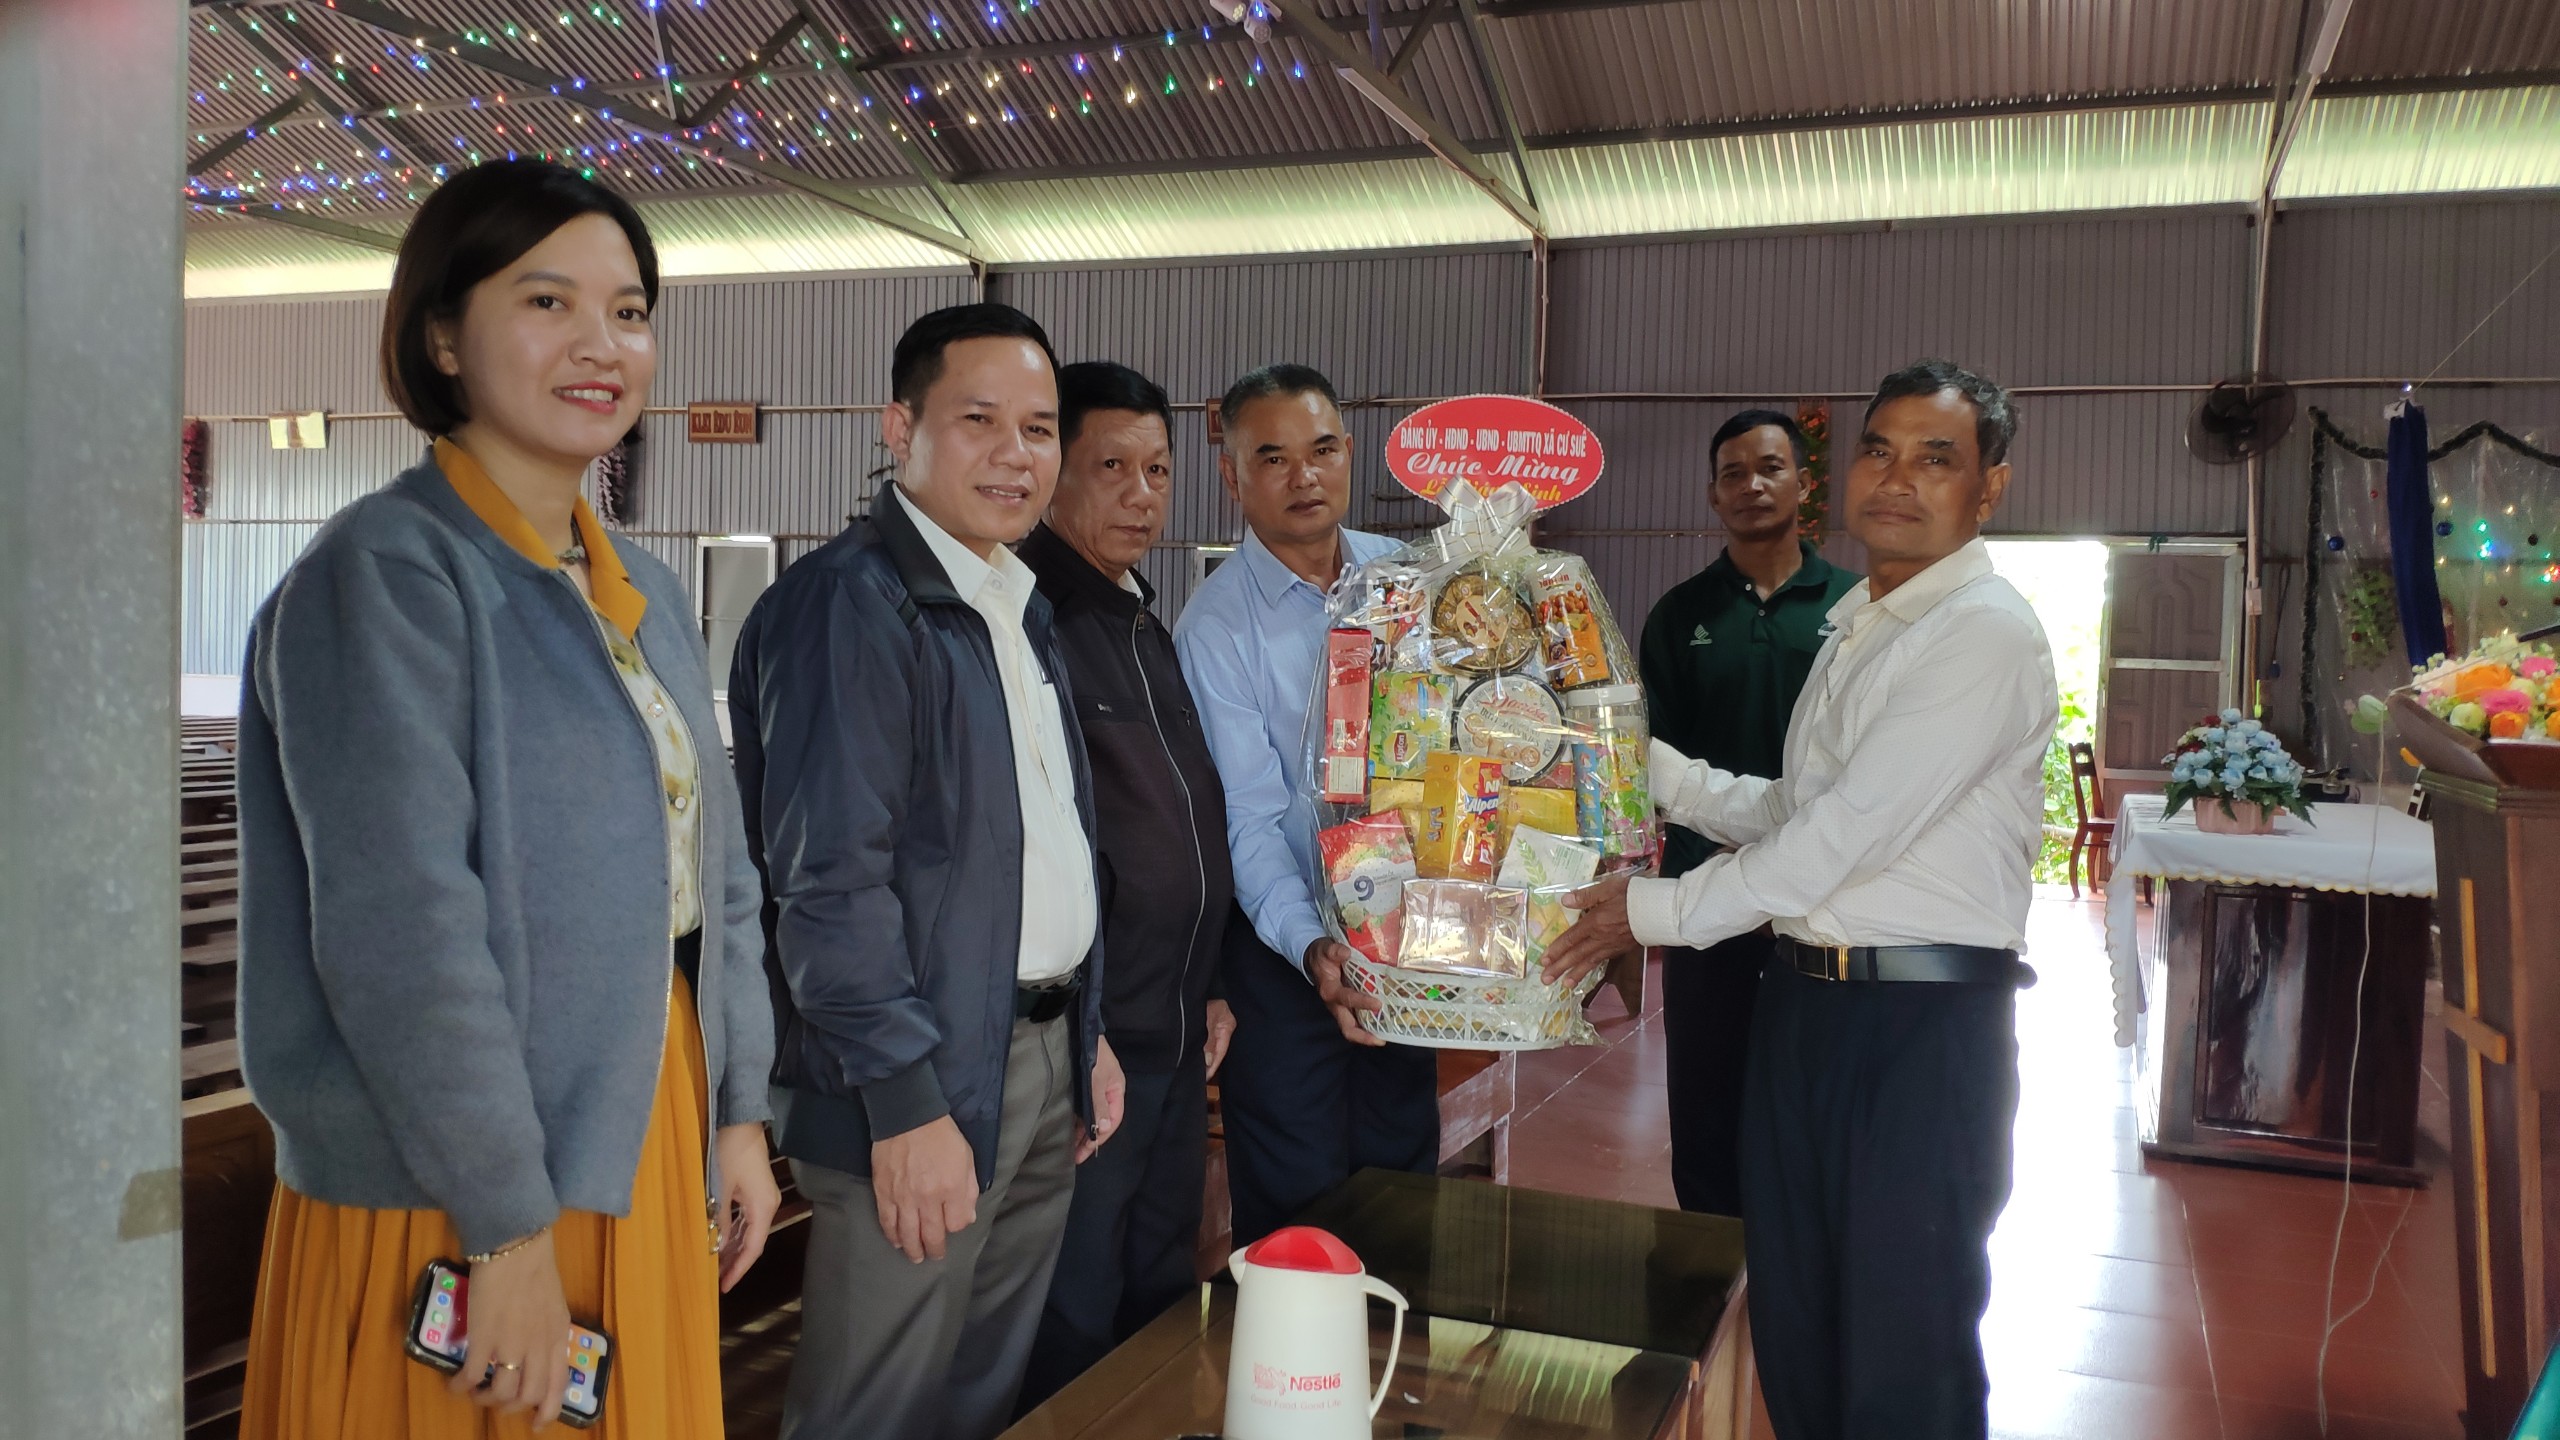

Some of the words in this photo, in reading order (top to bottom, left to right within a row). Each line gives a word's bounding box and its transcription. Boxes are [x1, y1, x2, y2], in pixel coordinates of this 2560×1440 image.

[1400, 419, 1424, 450] ĐẢNG
[1425, 419, 1438, 449] ỦY
[1444, 427, 1469, 450] HĐND
[1476, 428, 1500, 452] UBND
[1507, 430, 1542, 458] UBMTTQ
[1543, 428, 1555, 455] XÃ
[1557, 430, 1570, 457] CƯ
[1570, 430, 1587, 458] SUÊ
[1407, 452, 1483, 476] Chúc
[1487, 454, 1580, 486] Mừng
[1353, 875, 1375, 901] 9
